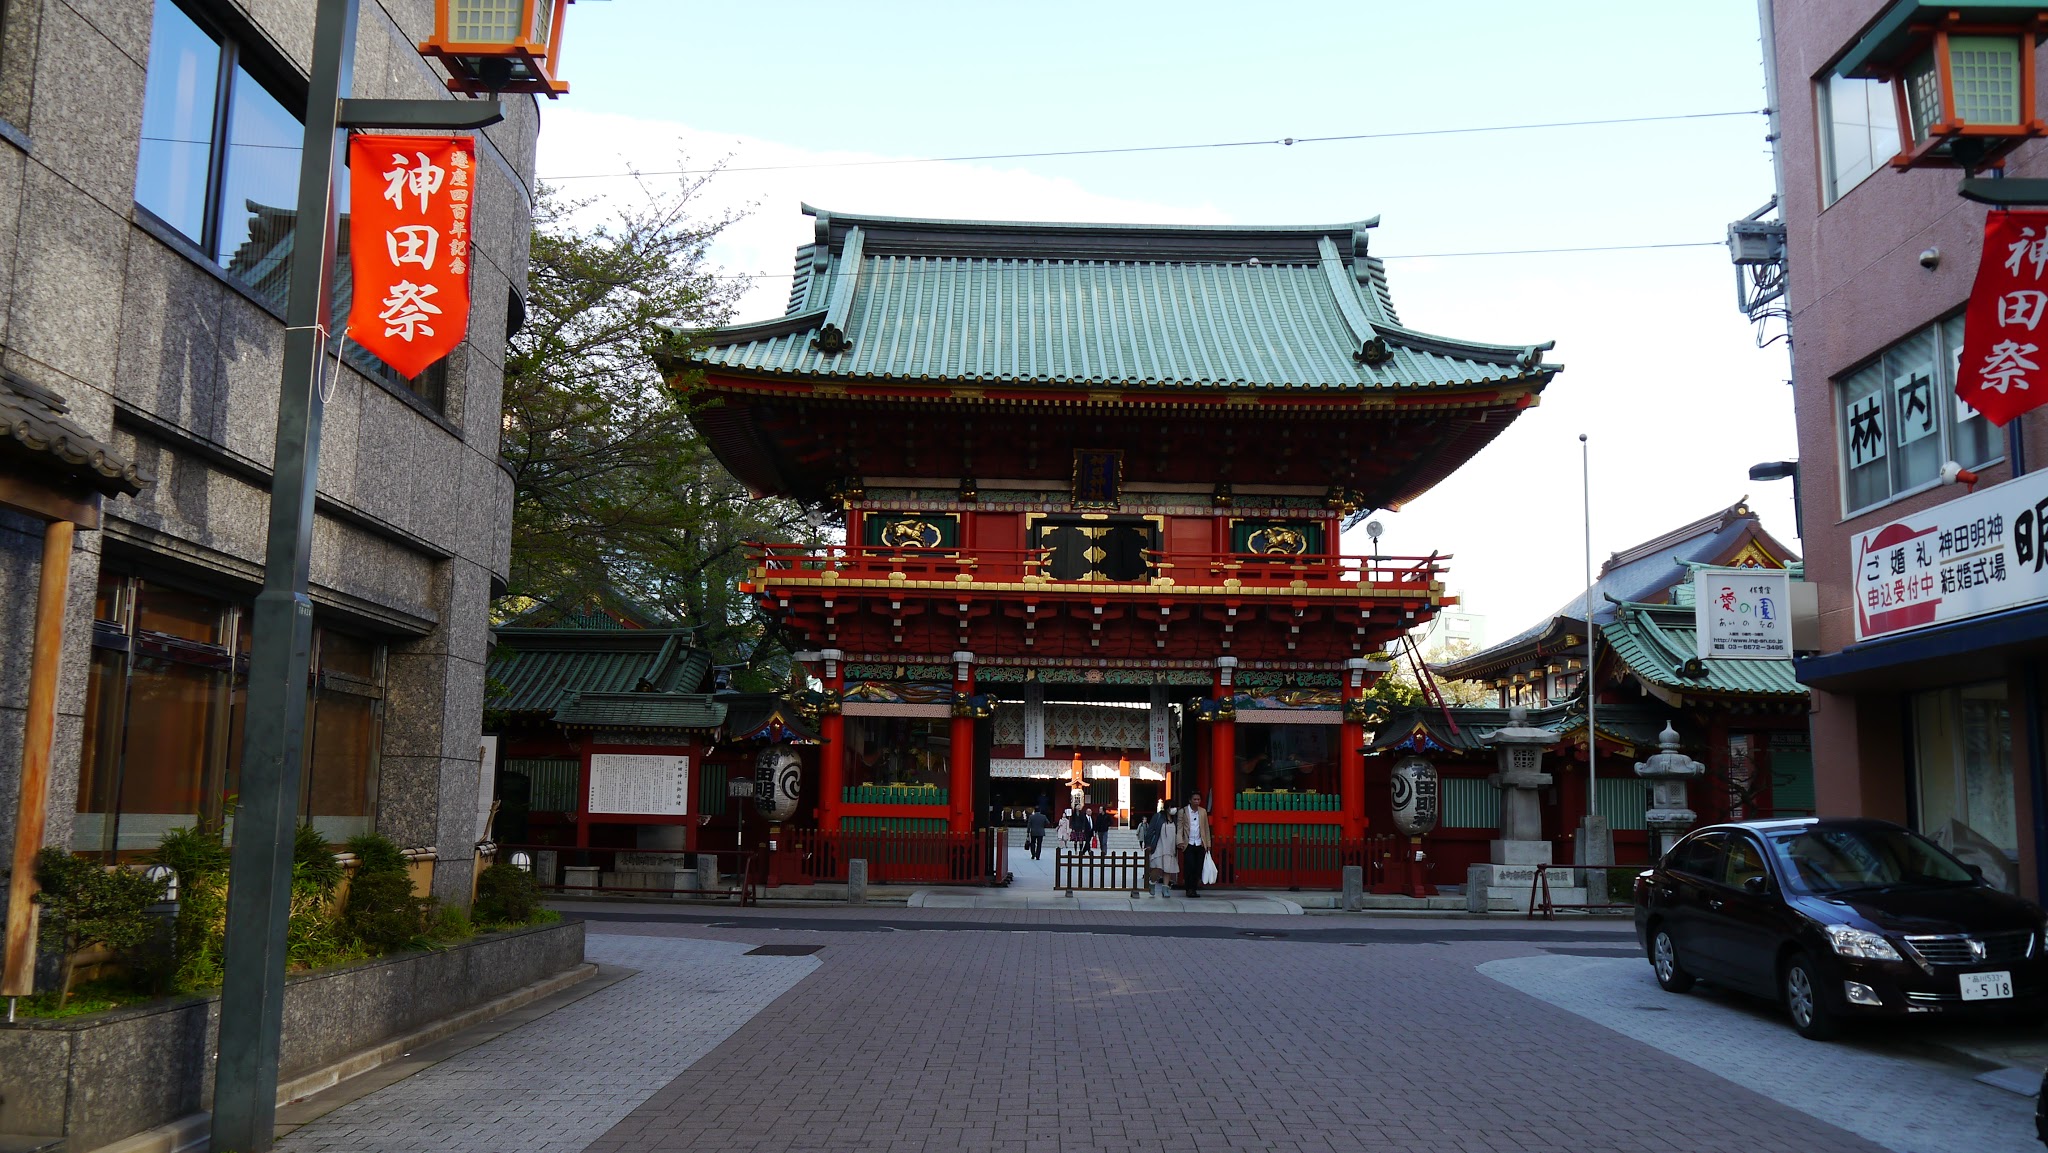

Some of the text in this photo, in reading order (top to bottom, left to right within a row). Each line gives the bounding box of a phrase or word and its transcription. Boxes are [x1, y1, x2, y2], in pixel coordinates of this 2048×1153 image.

[378, 151, 446, 342] 神田祭
[1978, 226, 2048, 394] 神田祭
[1938, 513, 2004, 558] 神田明神
[1866, 541, 1932, 582] ご婚礼
[1940, 552, 2006, 595] 結婚式場
[1867, 572, 1934, 610] 申込受付中
